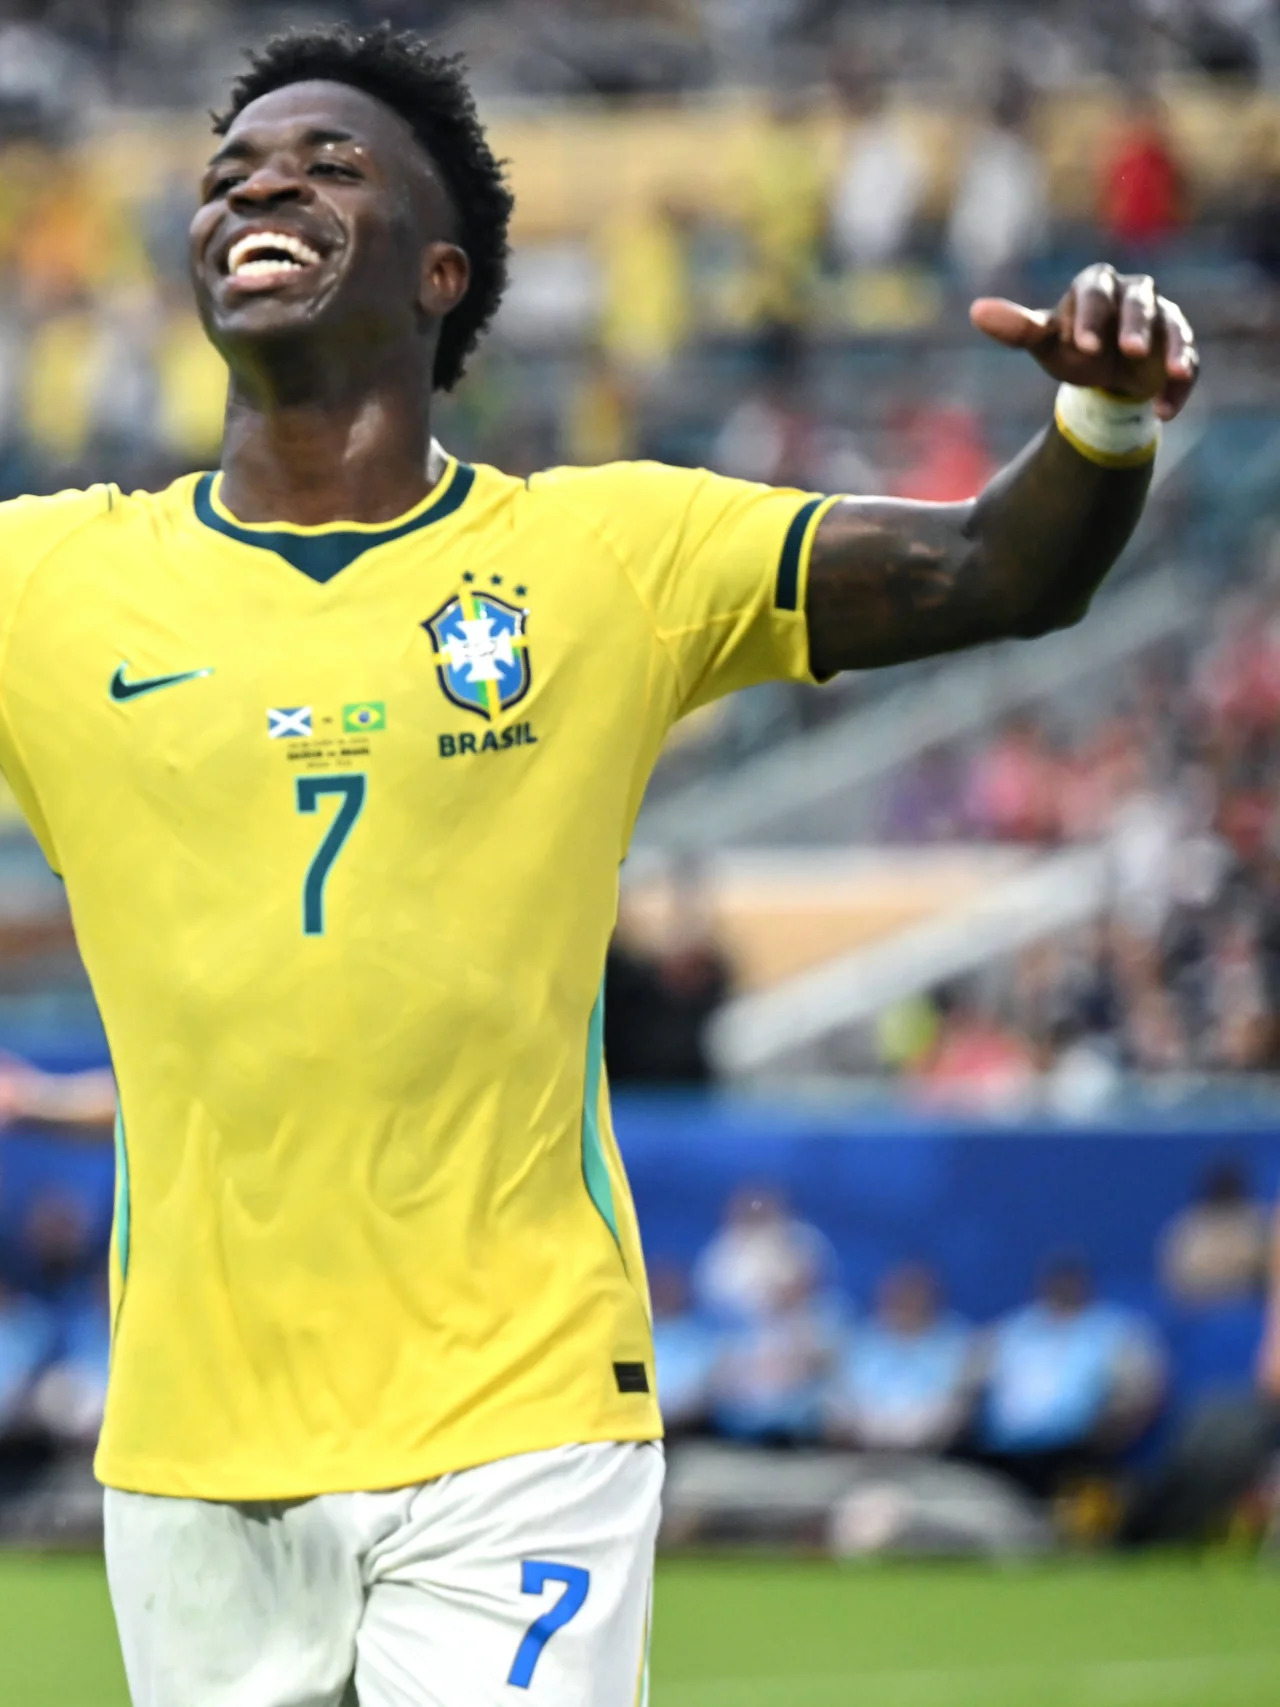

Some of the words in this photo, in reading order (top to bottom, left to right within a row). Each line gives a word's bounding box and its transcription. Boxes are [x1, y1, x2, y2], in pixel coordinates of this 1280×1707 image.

[438, 721, 538, 758] BRASIL
[295, 773, 366, 936] 7
[507, 1559, 590, 1689] 7
